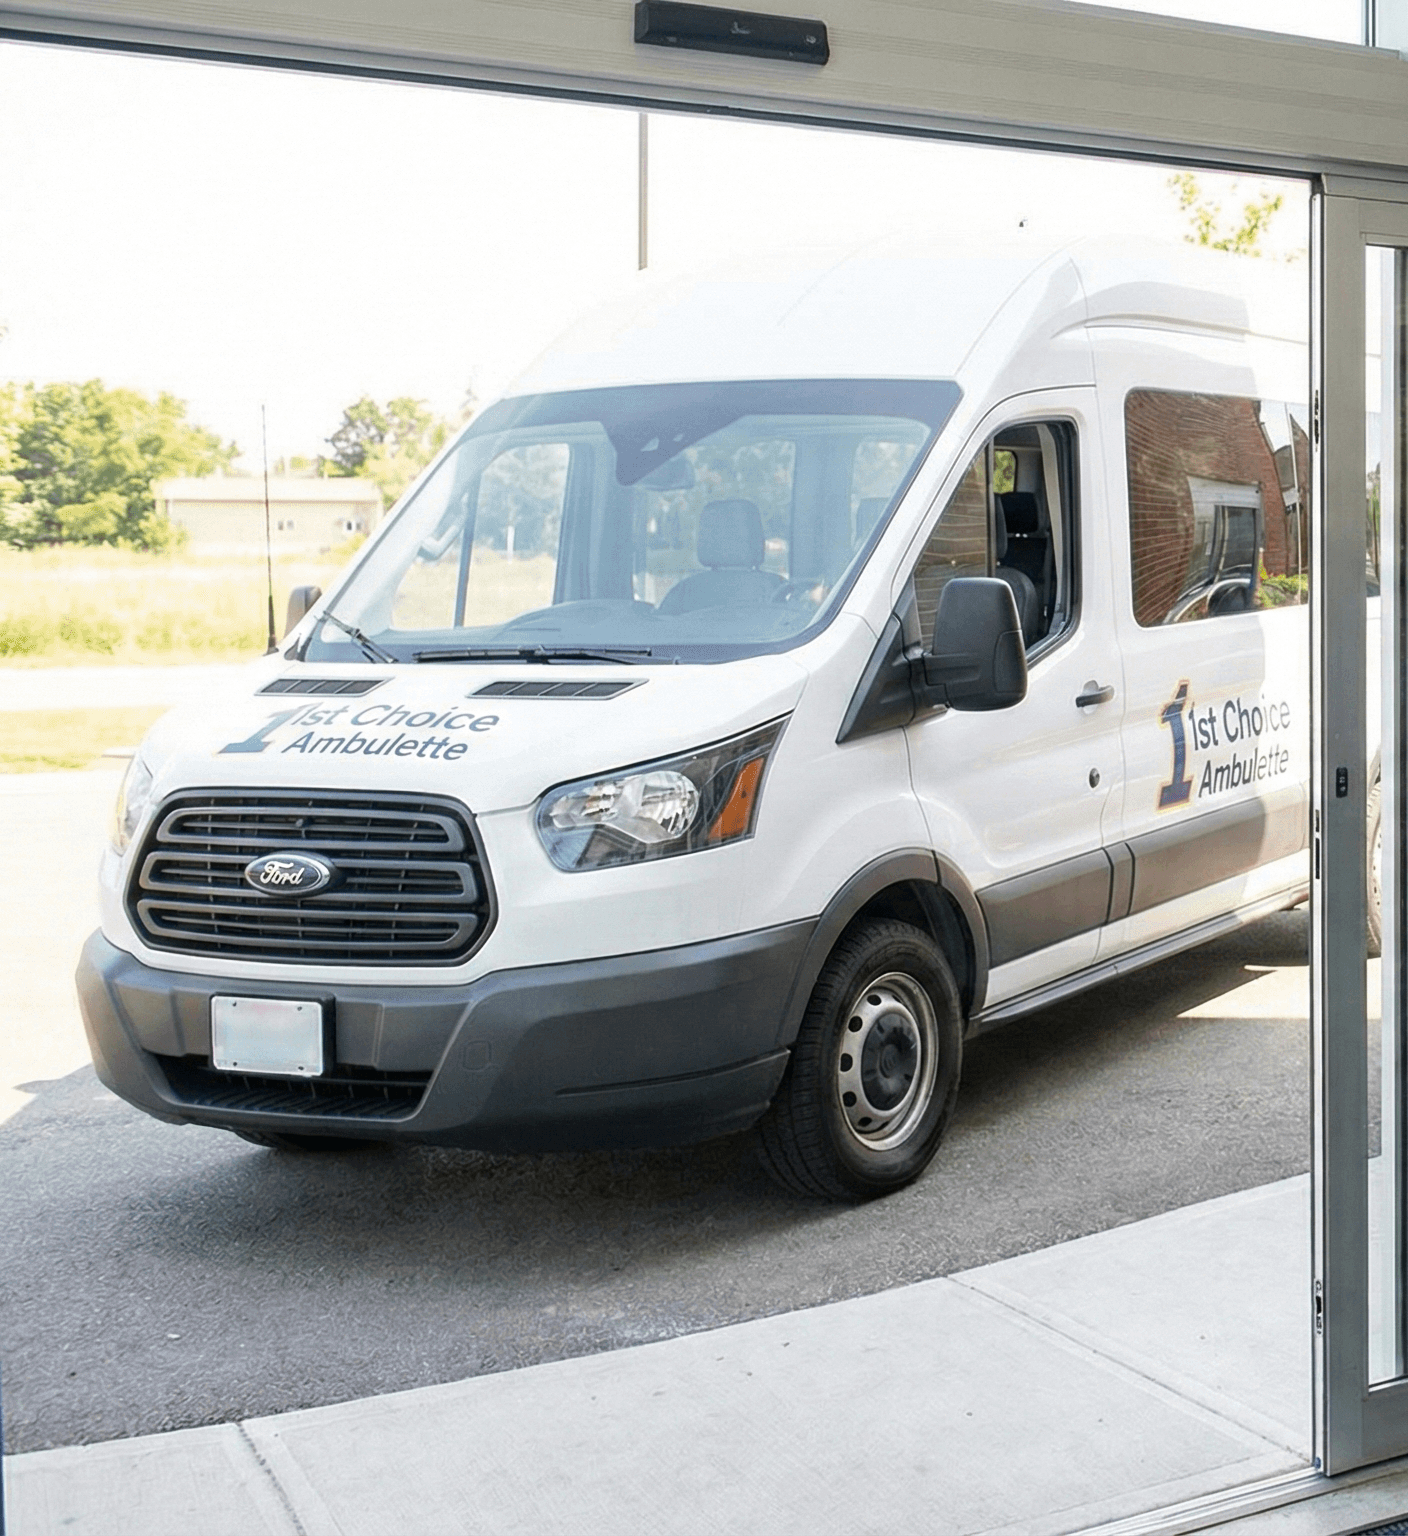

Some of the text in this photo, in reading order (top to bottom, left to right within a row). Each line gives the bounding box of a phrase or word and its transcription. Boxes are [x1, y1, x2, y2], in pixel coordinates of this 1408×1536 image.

[350, 704, 500, 732] Choice
[1188, 701, 1219, 751] 1st
[1223, 693, 1291, 743] Choice
[281, 731, 469, 761] Ambulette
[1198, 744, 1289, 798] Ambulette
[260, 860, 305, 885] Ford
